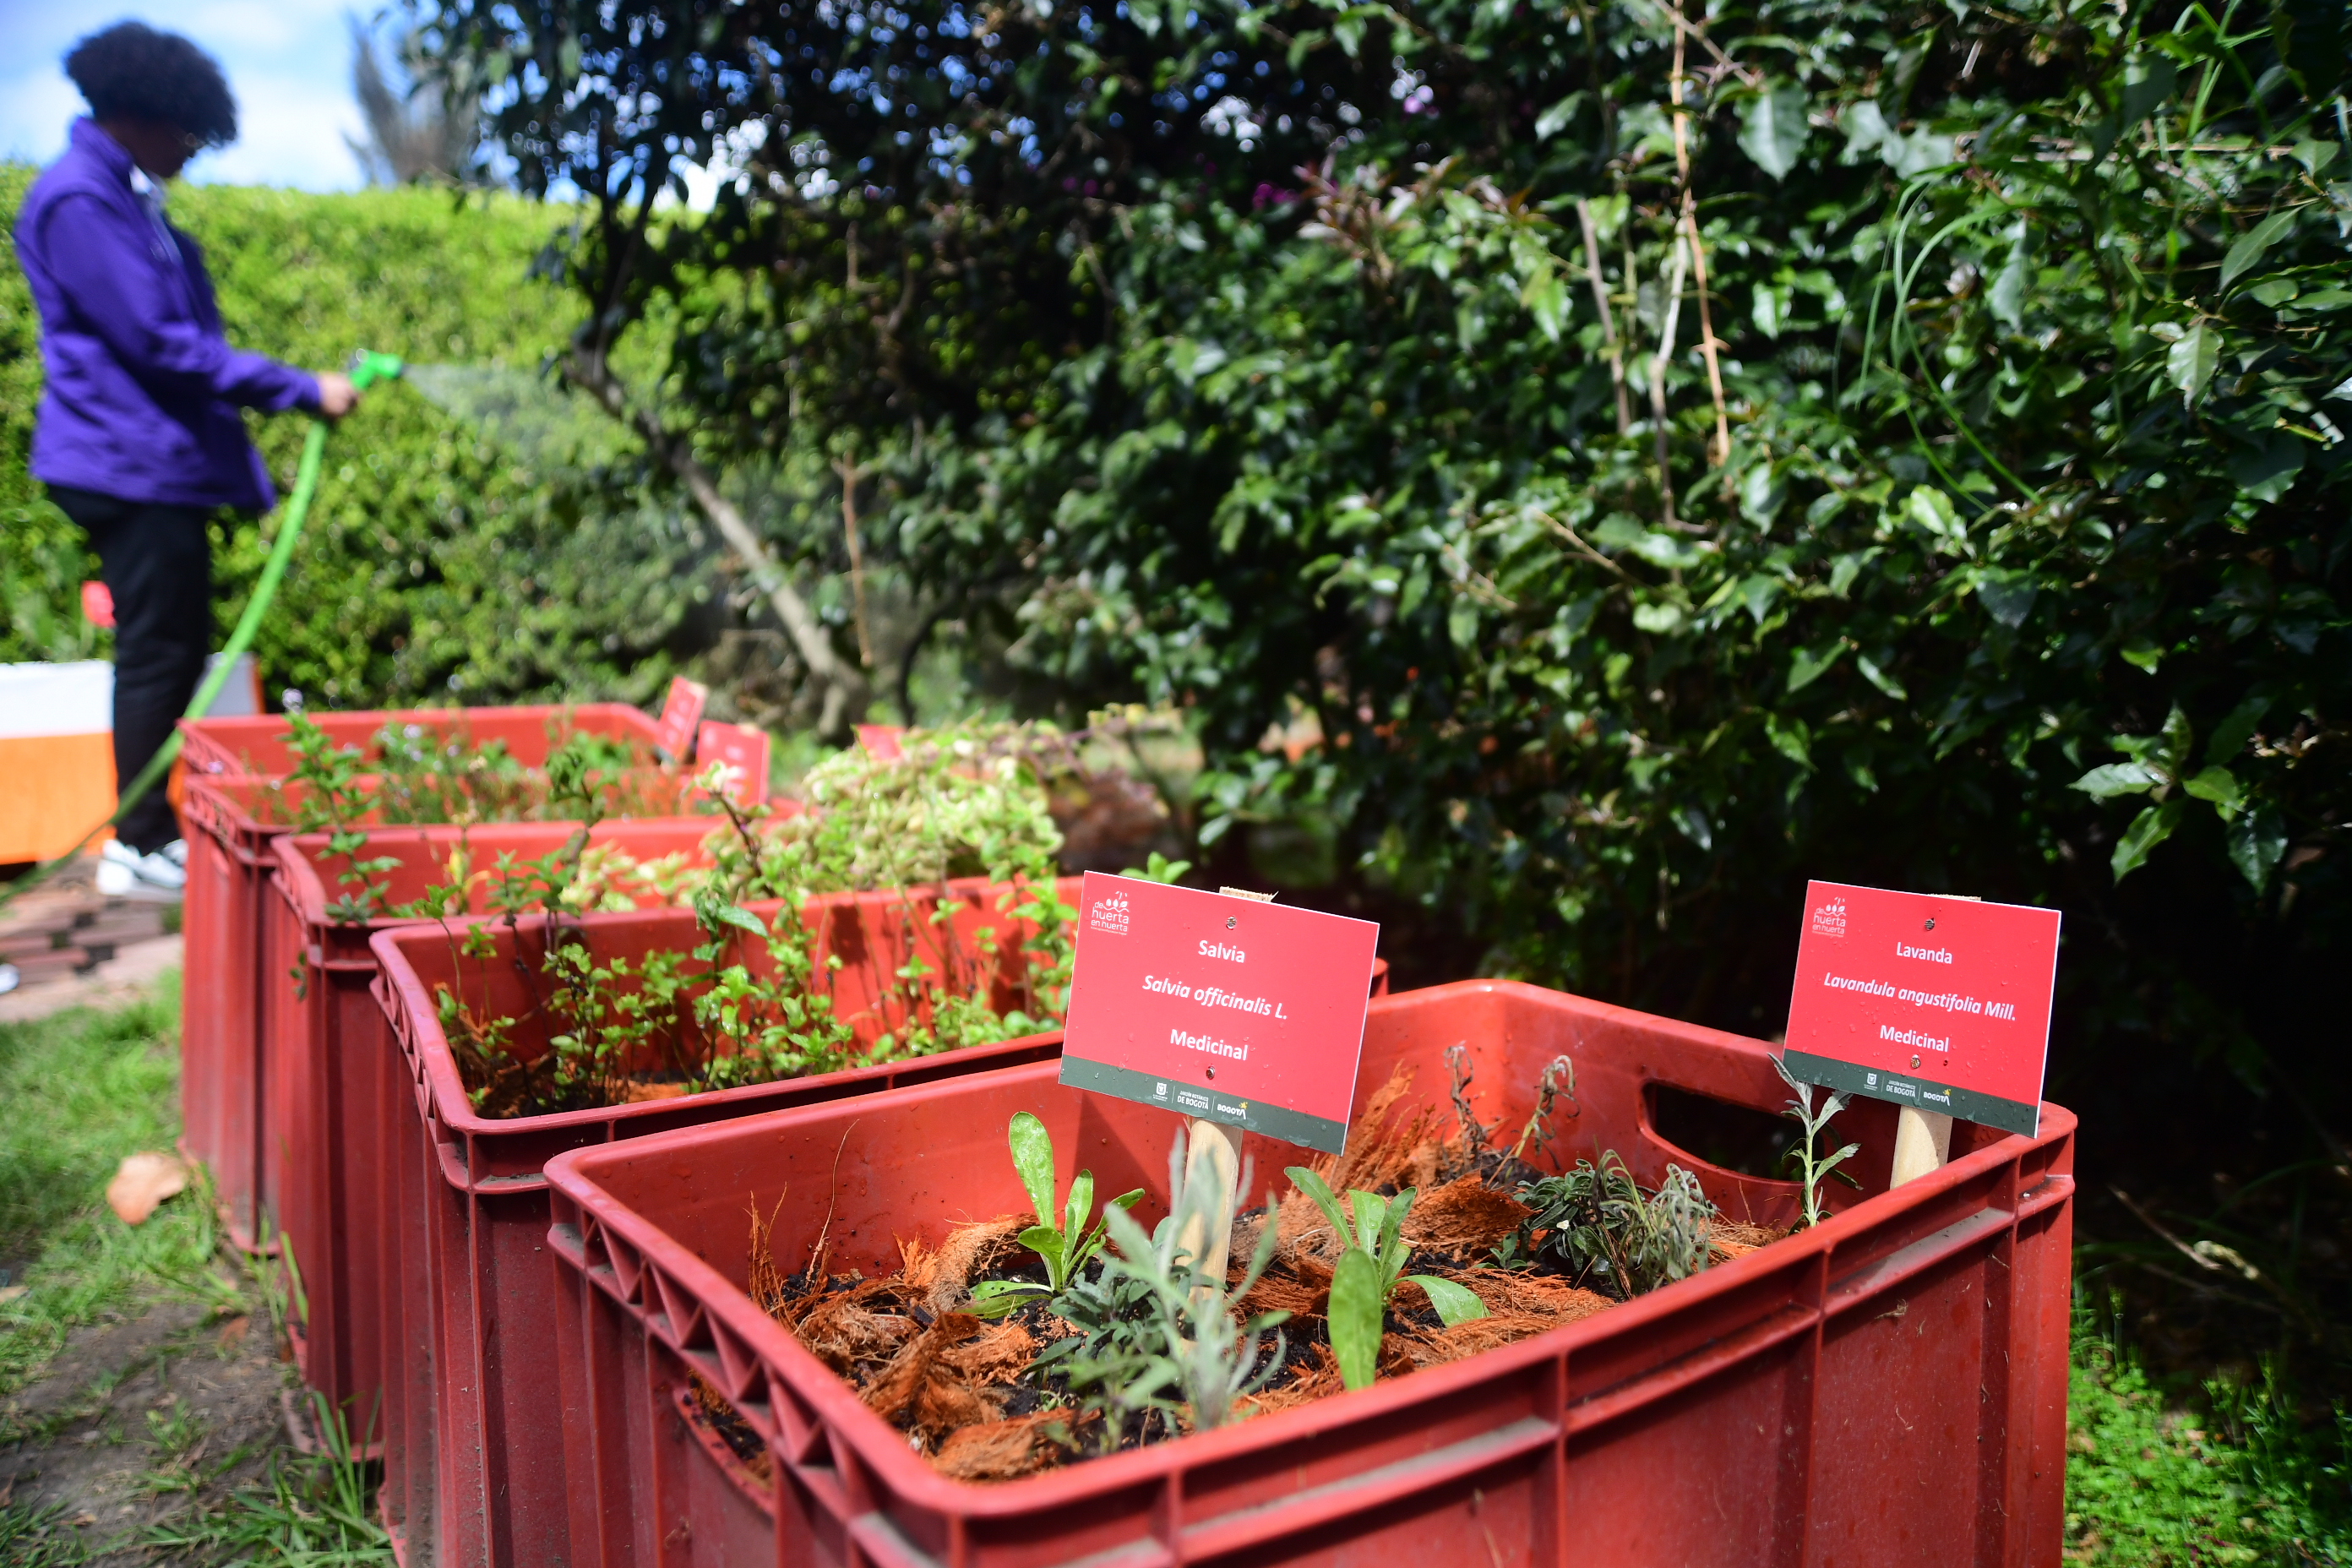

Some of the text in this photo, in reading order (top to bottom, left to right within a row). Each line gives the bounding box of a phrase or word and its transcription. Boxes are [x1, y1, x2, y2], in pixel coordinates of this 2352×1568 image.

[1095, 901, 1103, 909] de
[1092, 906, 1129, 924] huerta
[1813, 912, 1846, 927] huerta
[1102, 920, 1127, 932] huerta
[1821, 924, 1845, 934] huerta
[1198, 939, 1245, 963] Salvia
[1896, 942, 1952, 964] Lavanda
[1142, 975, 1287, 1020] Salvia officinalis L.
[1823, 972, 2016, 1021] Lavandula angustifolia Mill.
[1170, 1028, 1248, 1061] Medicinal
[1880, 1025, 1949, 1053] Medicinal
[1894, 1086, 1915, 1097] BOGOTÁ
[1185, 1097, 1208, 1110] BOGOTÁ
